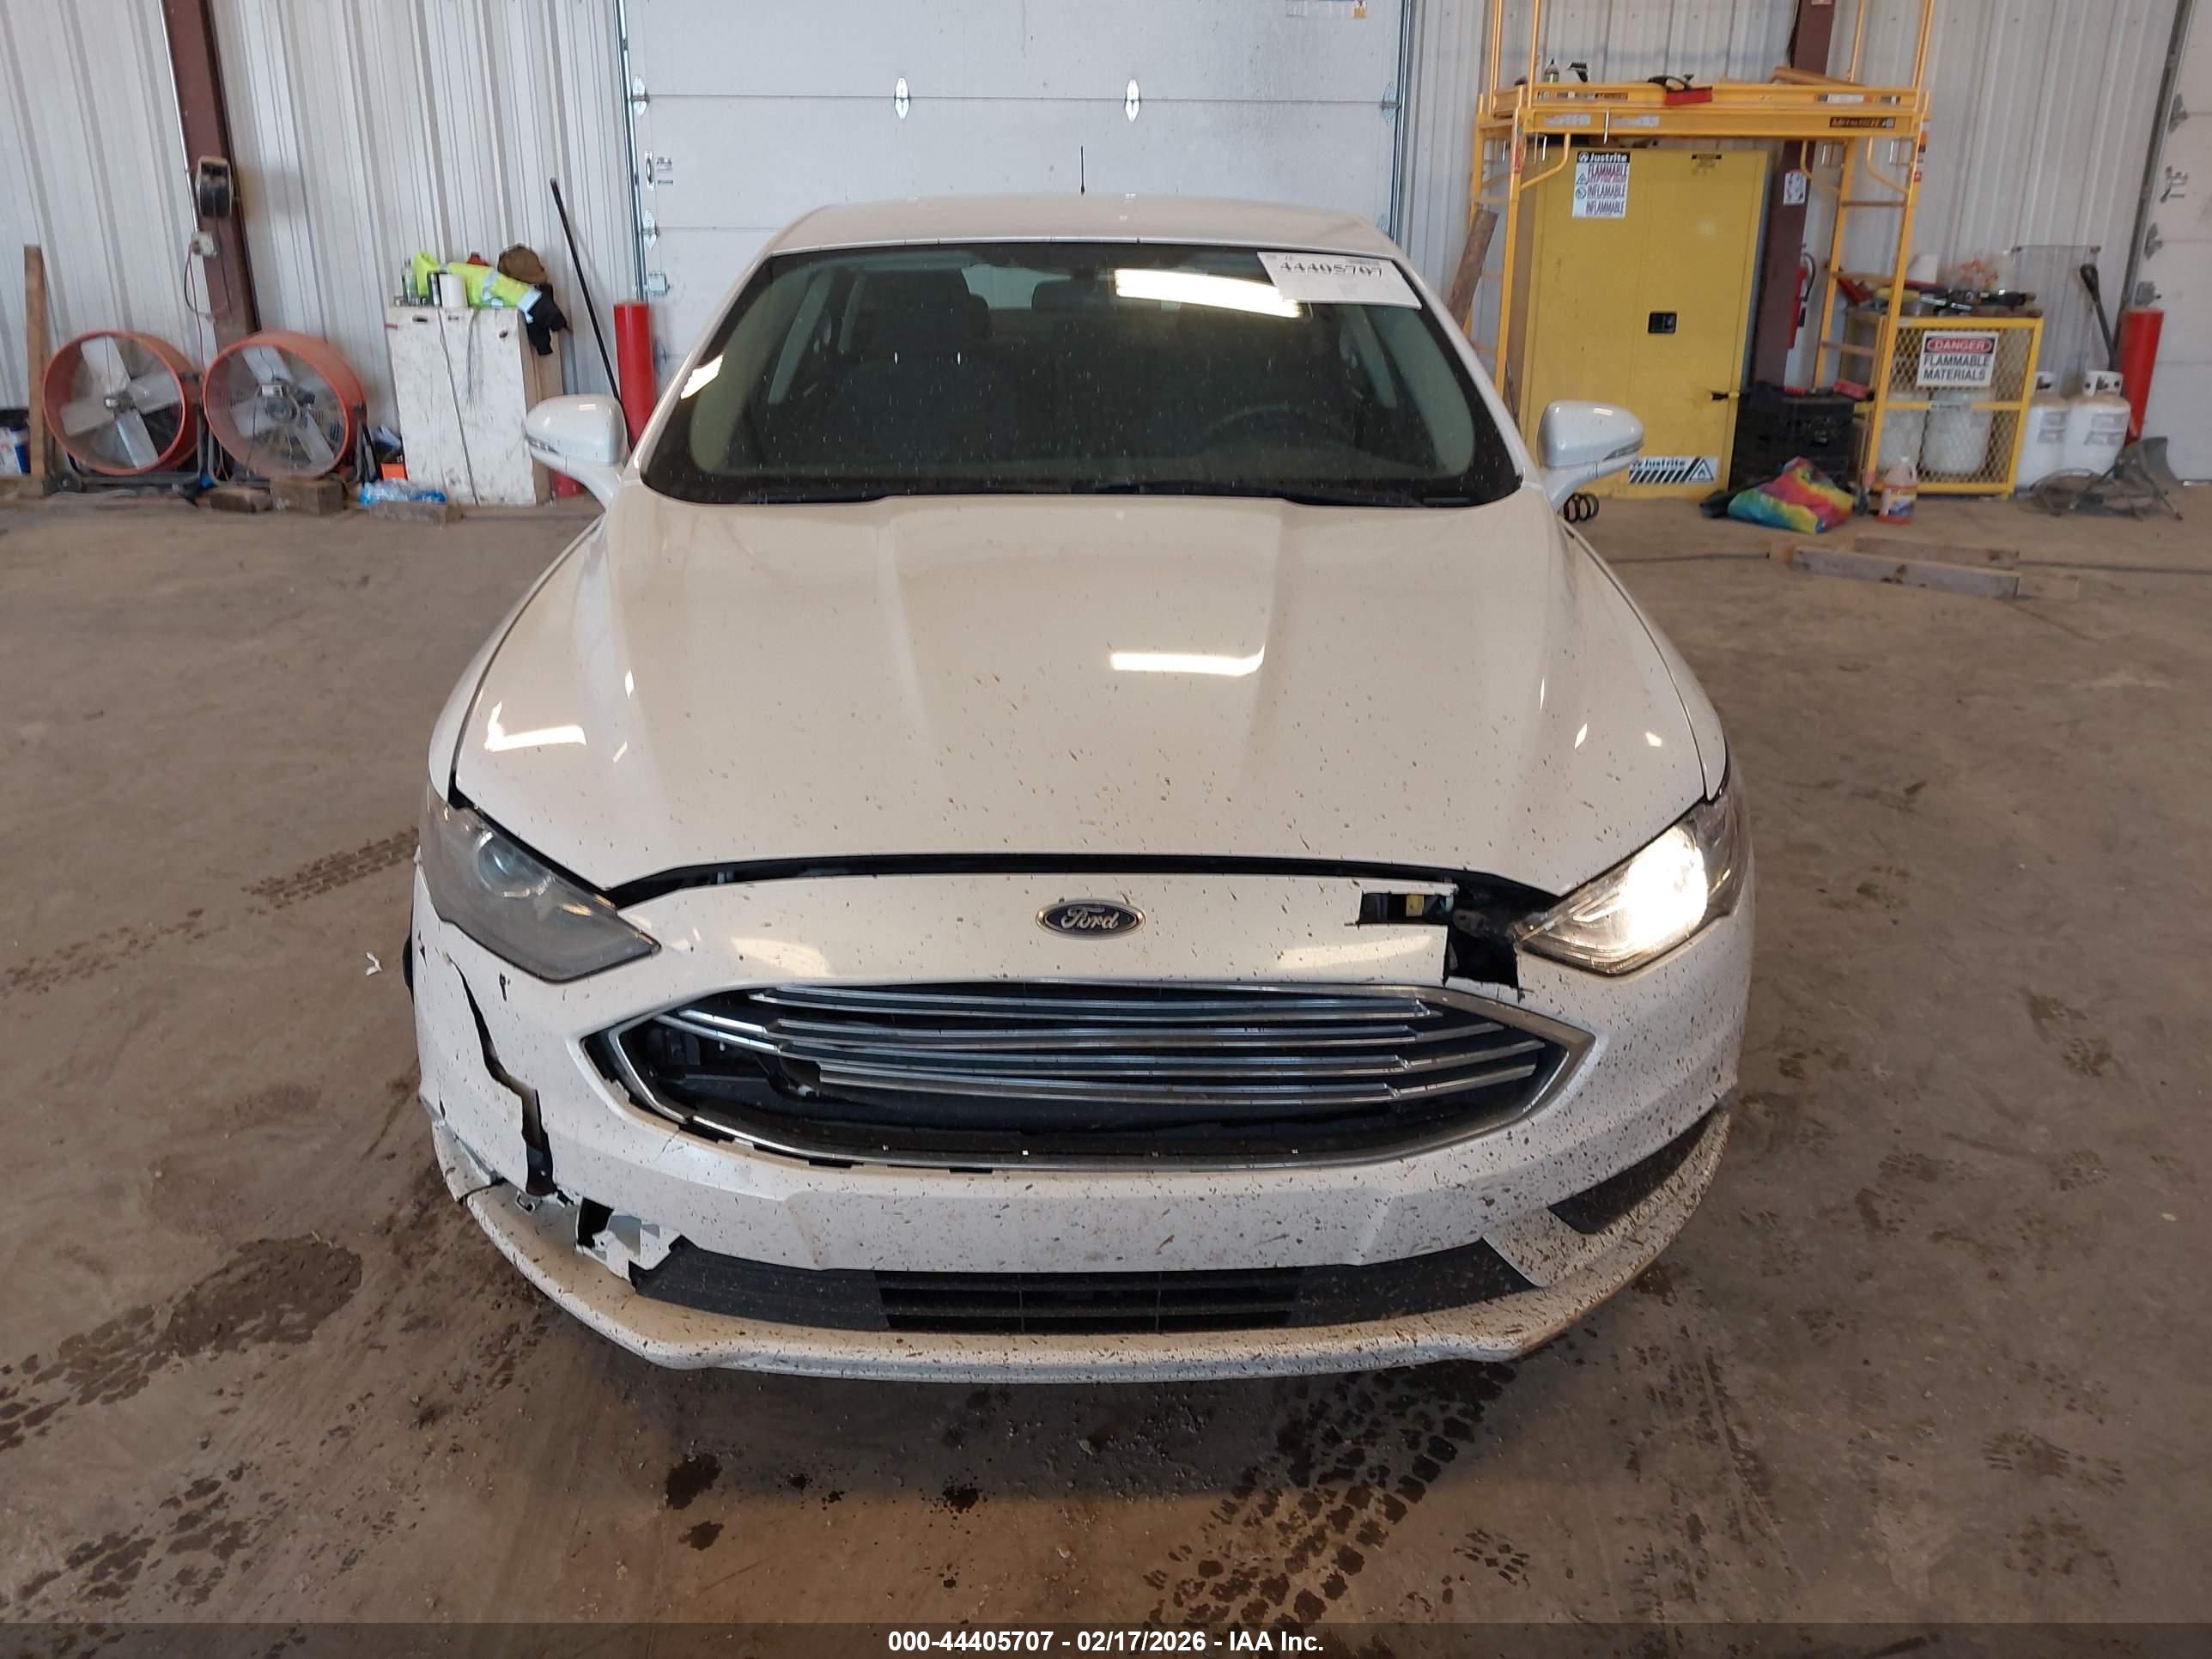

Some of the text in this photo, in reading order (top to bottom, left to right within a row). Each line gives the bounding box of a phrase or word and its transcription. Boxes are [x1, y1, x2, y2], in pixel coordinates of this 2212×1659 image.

[1589, 152, 1628, 162] Justrite
[1589, 163, 1628, 177] FLAMMABLE
[1934, 339, 1986, 350] DANGER
[1923, 355, 1989, 367] FLAMMABLE
[1923, 368, 1986, 380] MATERIALS
[1060, 907, 1120, 929] Ford
